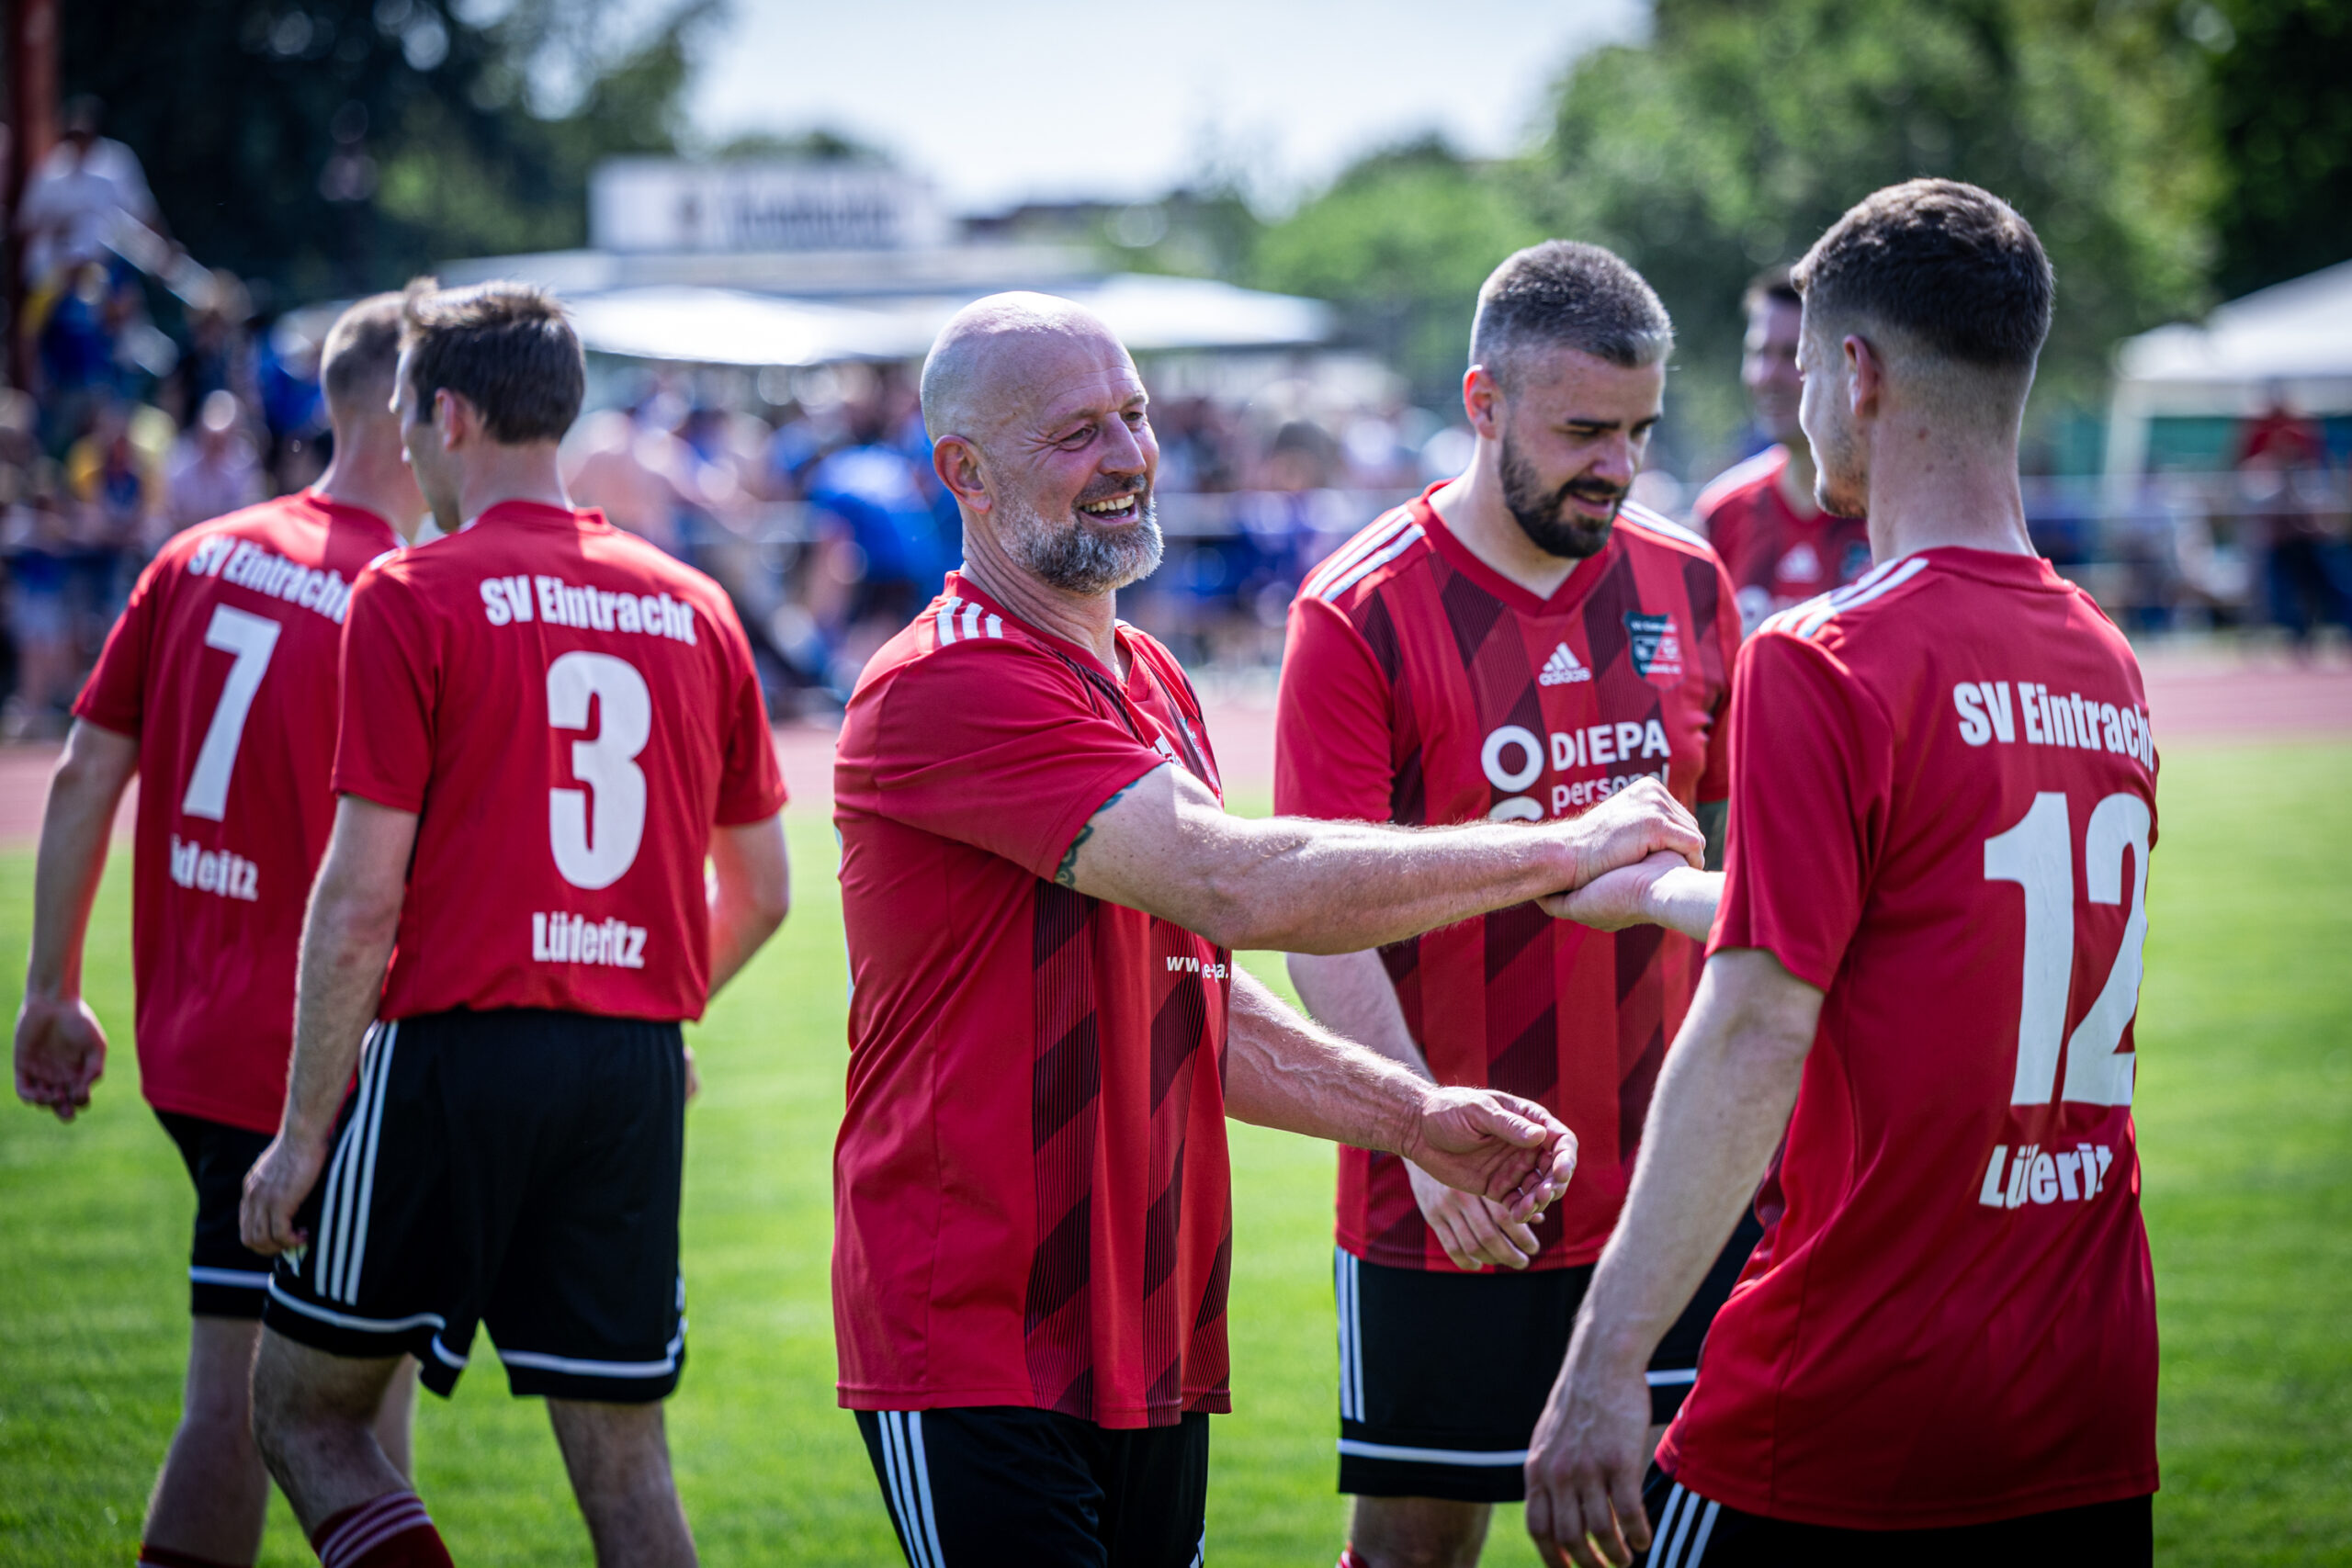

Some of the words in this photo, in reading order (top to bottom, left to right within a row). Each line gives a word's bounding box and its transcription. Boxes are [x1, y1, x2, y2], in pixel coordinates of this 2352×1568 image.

[187, 535, 236, 578] SV
[480, 574, 534, 626] SV
[535, 574, 697, 647] Eintracht
[1539, 667, 1591, 686] adidas
[183, 603, 282, 822] 7
[1953, 681, 2016, 746] SV
[546, 650, 651, 890] 3
[1550, 719, 1671, 772] DIEPA
[1551, 762, 1670, 816] persol
[1984, 791, 2152, 1106] 12
